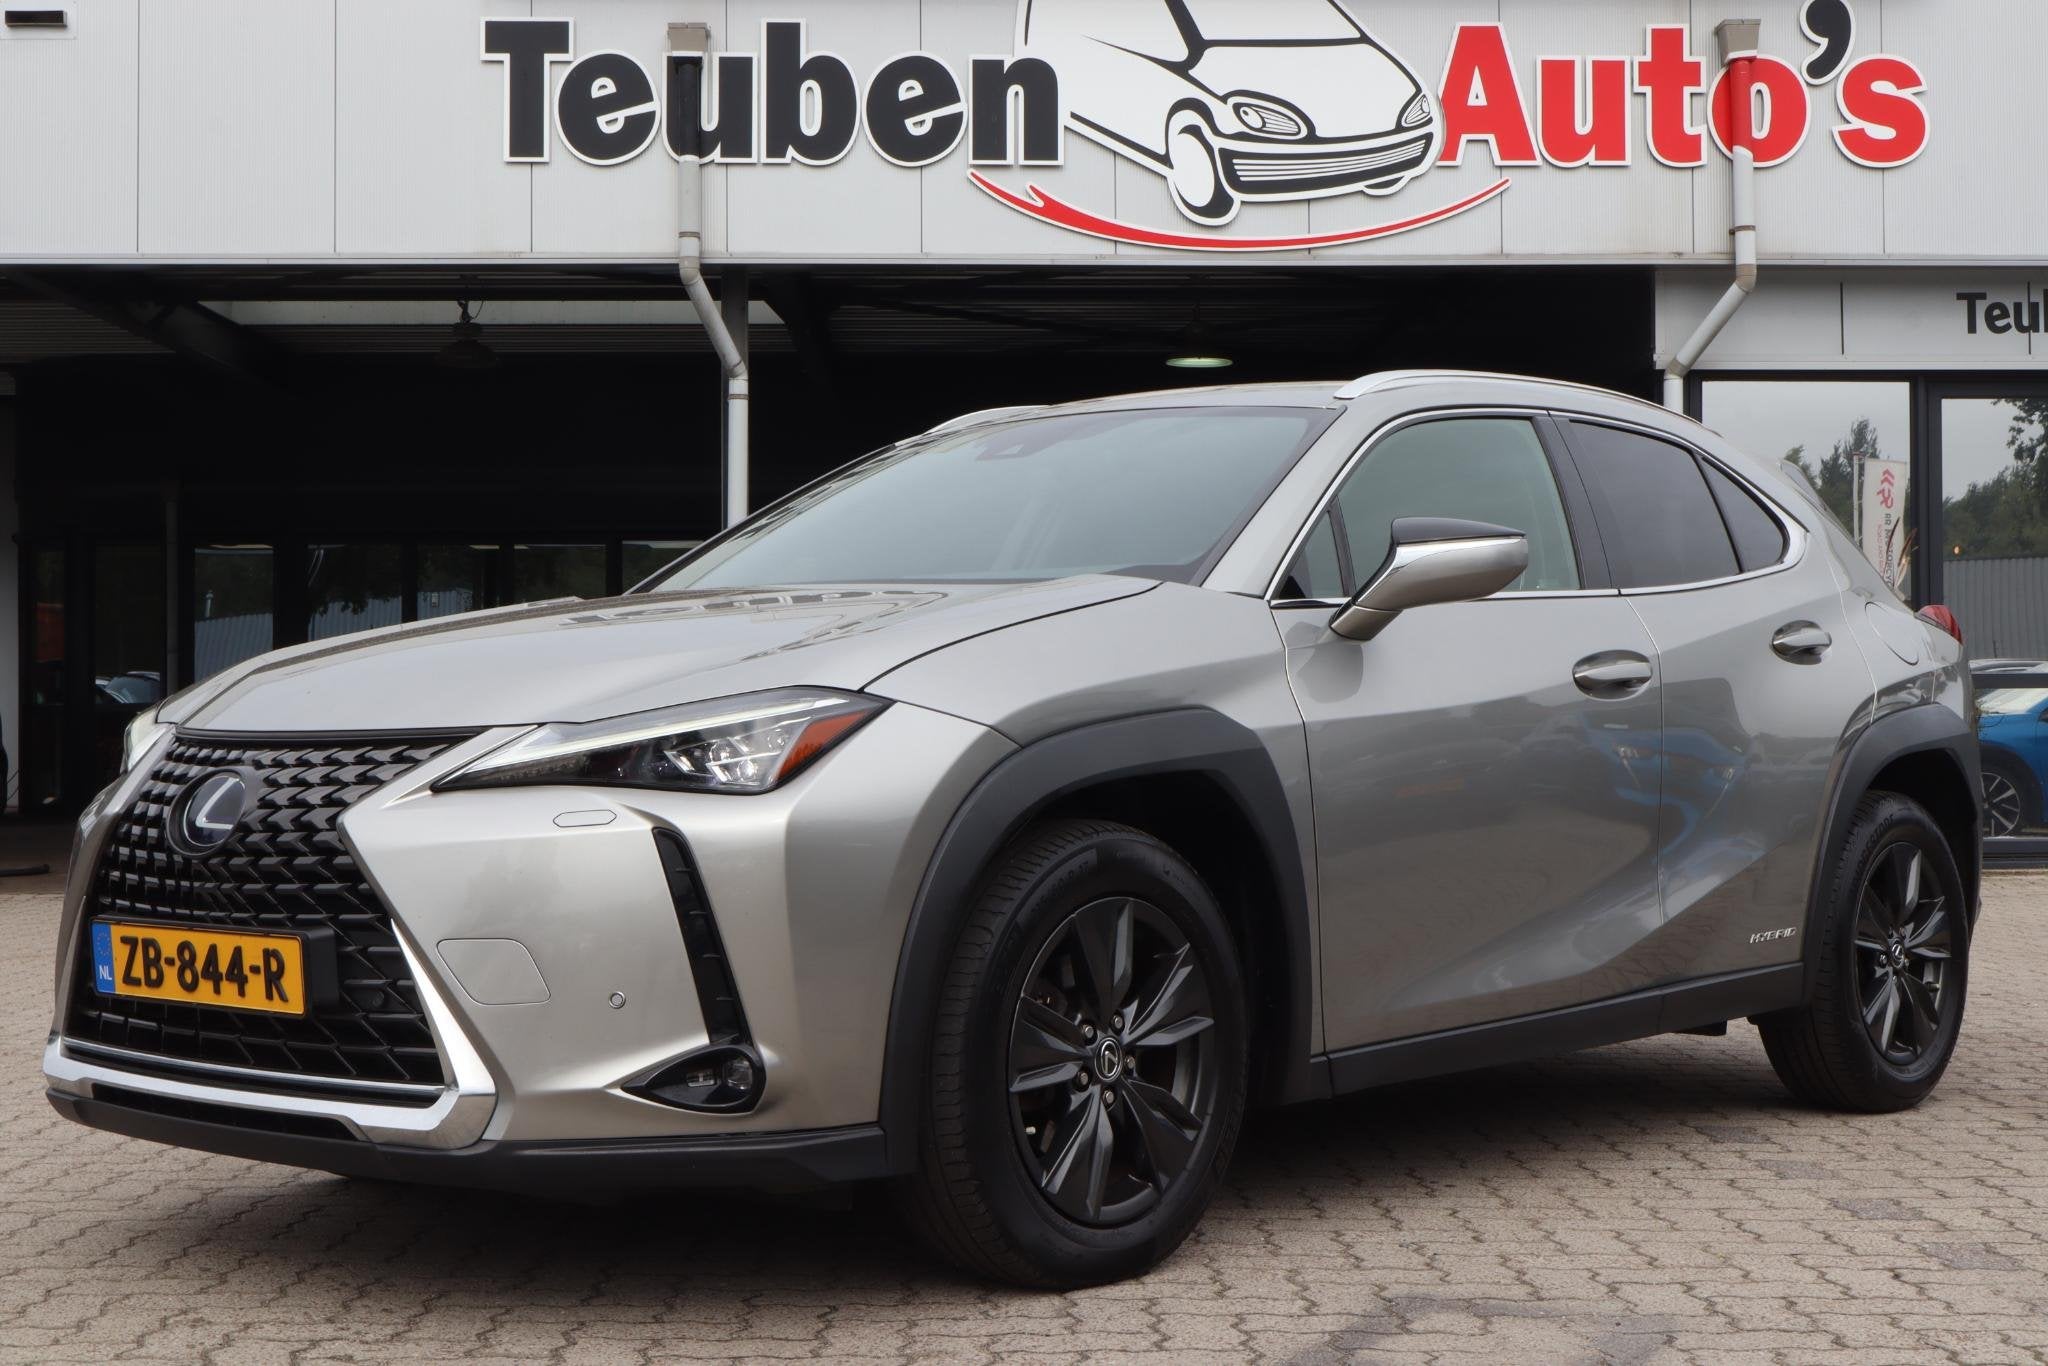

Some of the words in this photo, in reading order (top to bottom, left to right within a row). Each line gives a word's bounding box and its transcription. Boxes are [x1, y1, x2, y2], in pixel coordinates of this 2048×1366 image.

[482, 18, 1062, 165] Teuben
[1438, 0, 1928, 167] Auto's
[1749, 926, 1797, 944] HYBRID
[98, 964, 113, 982] NL
[120, 935, 289, 1003] ZB-844-R
